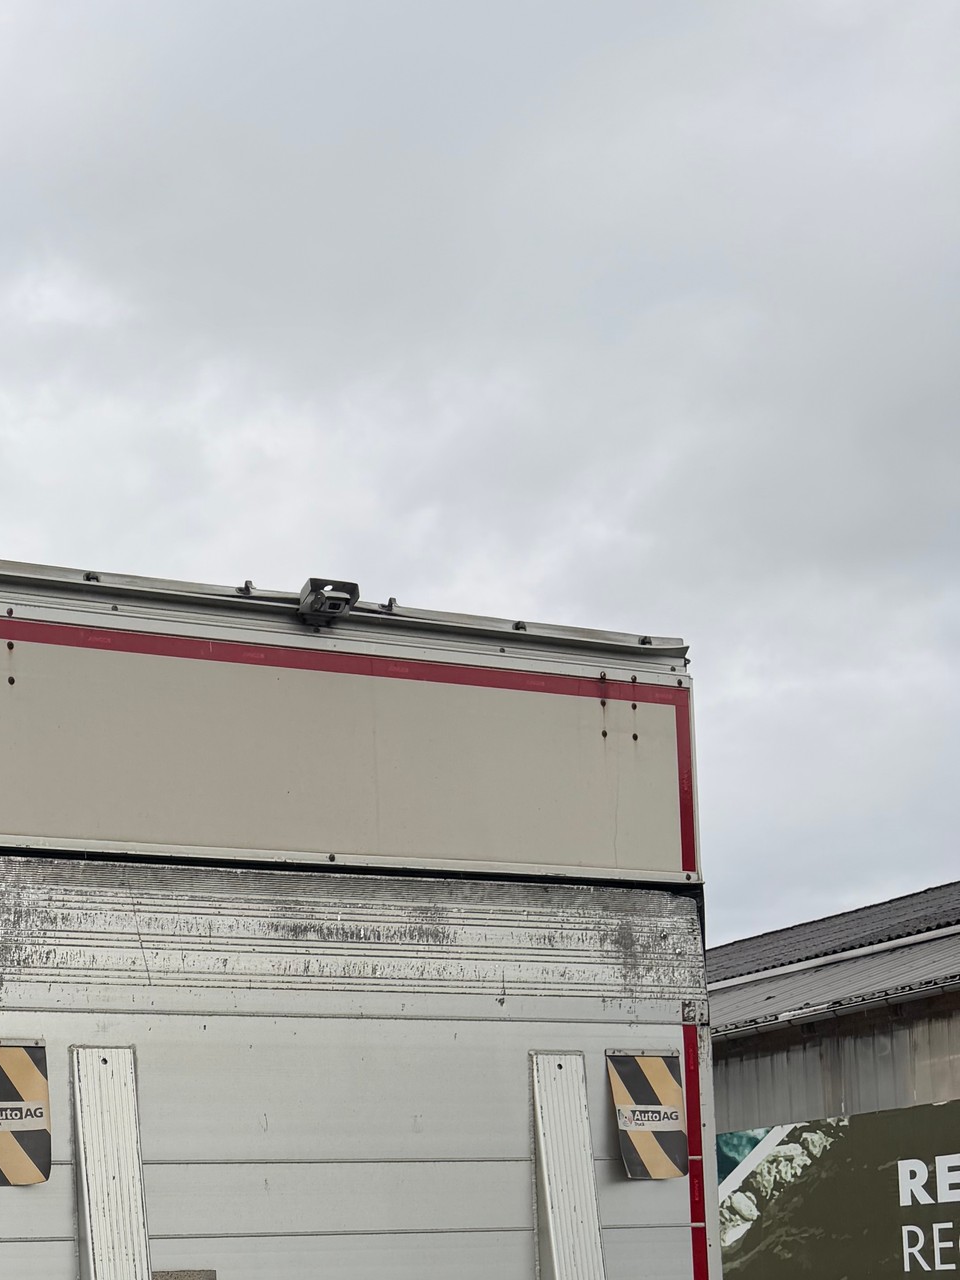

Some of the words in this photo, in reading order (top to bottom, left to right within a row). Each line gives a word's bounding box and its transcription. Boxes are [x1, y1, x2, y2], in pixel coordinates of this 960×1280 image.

[24, 1108, 44, 1118] AG
[634, 1111, 660, 1121] Auto
[662, 1111, 679, 1121] AG
[901, 1222, 960, 1272] RE
